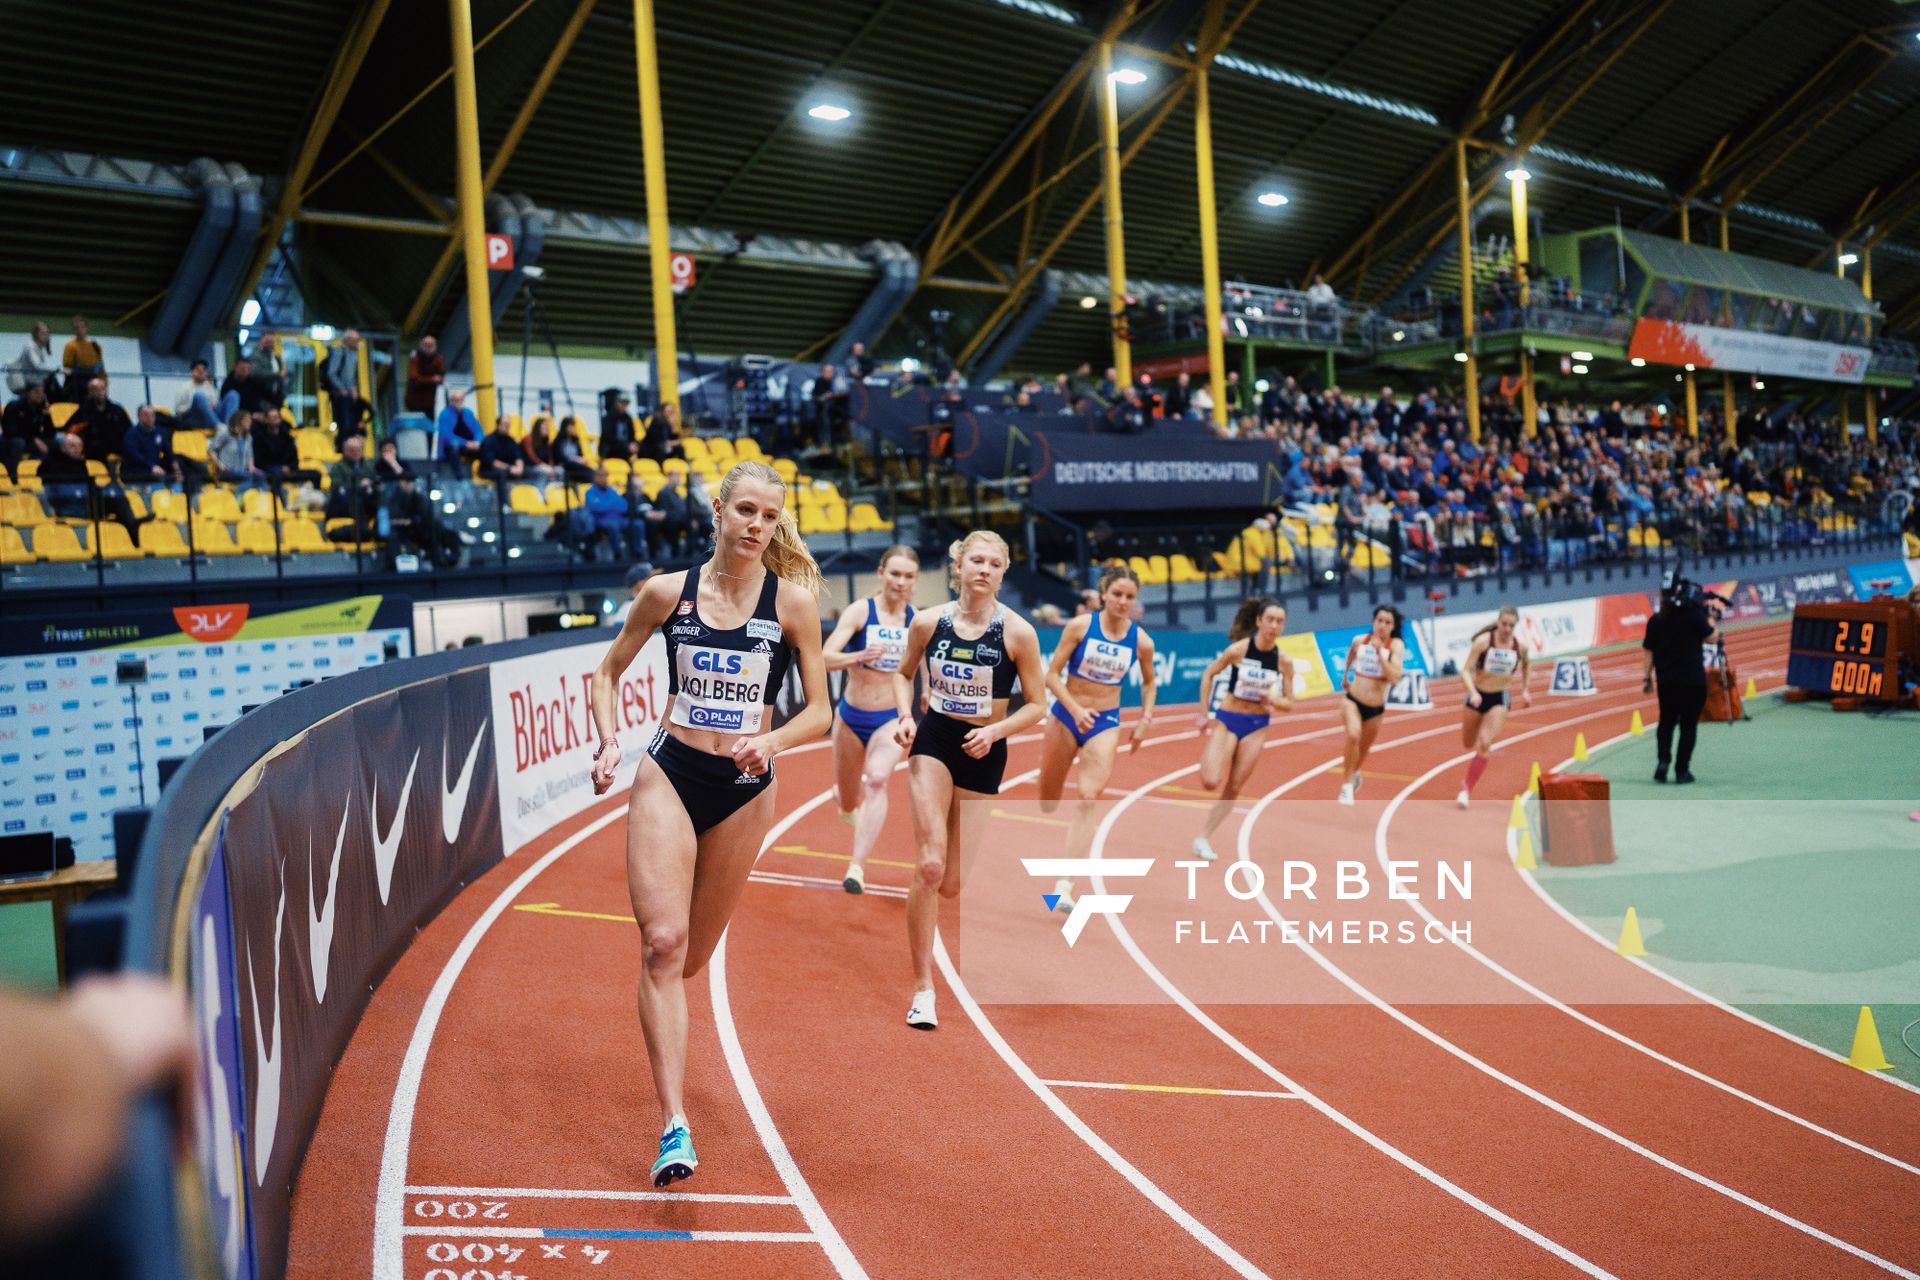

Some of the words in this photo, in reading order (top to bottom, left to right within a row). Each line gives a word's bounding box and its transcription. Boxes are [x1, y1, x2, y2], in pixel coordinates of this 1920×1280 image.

[488, 237, 509, 264] P
[1055, 461, 1134, 484] DEUTSCHE
[1135, 460, 1259, 484] MEISTERSCHAFTEN
[878, 628, 902, 640] GLS
[1835, 620, 1874, 655] 2.9
[1097, 643, 1119, 657] GLS
[1557, 663, 1575, 689] 3
[681, 674, 760, 704] KOLBERG
[931, 677, 988, 697] KALLABIS
[509, 675, 581, 774] Black
[710, 711, 741, 723] PLAN
[734, 777, 760, 785] adidas
[414, 1200, 510, 1219] 200
[426, 1242, 526, 1263] 400
[580, 1244, 610, 1265] 4
